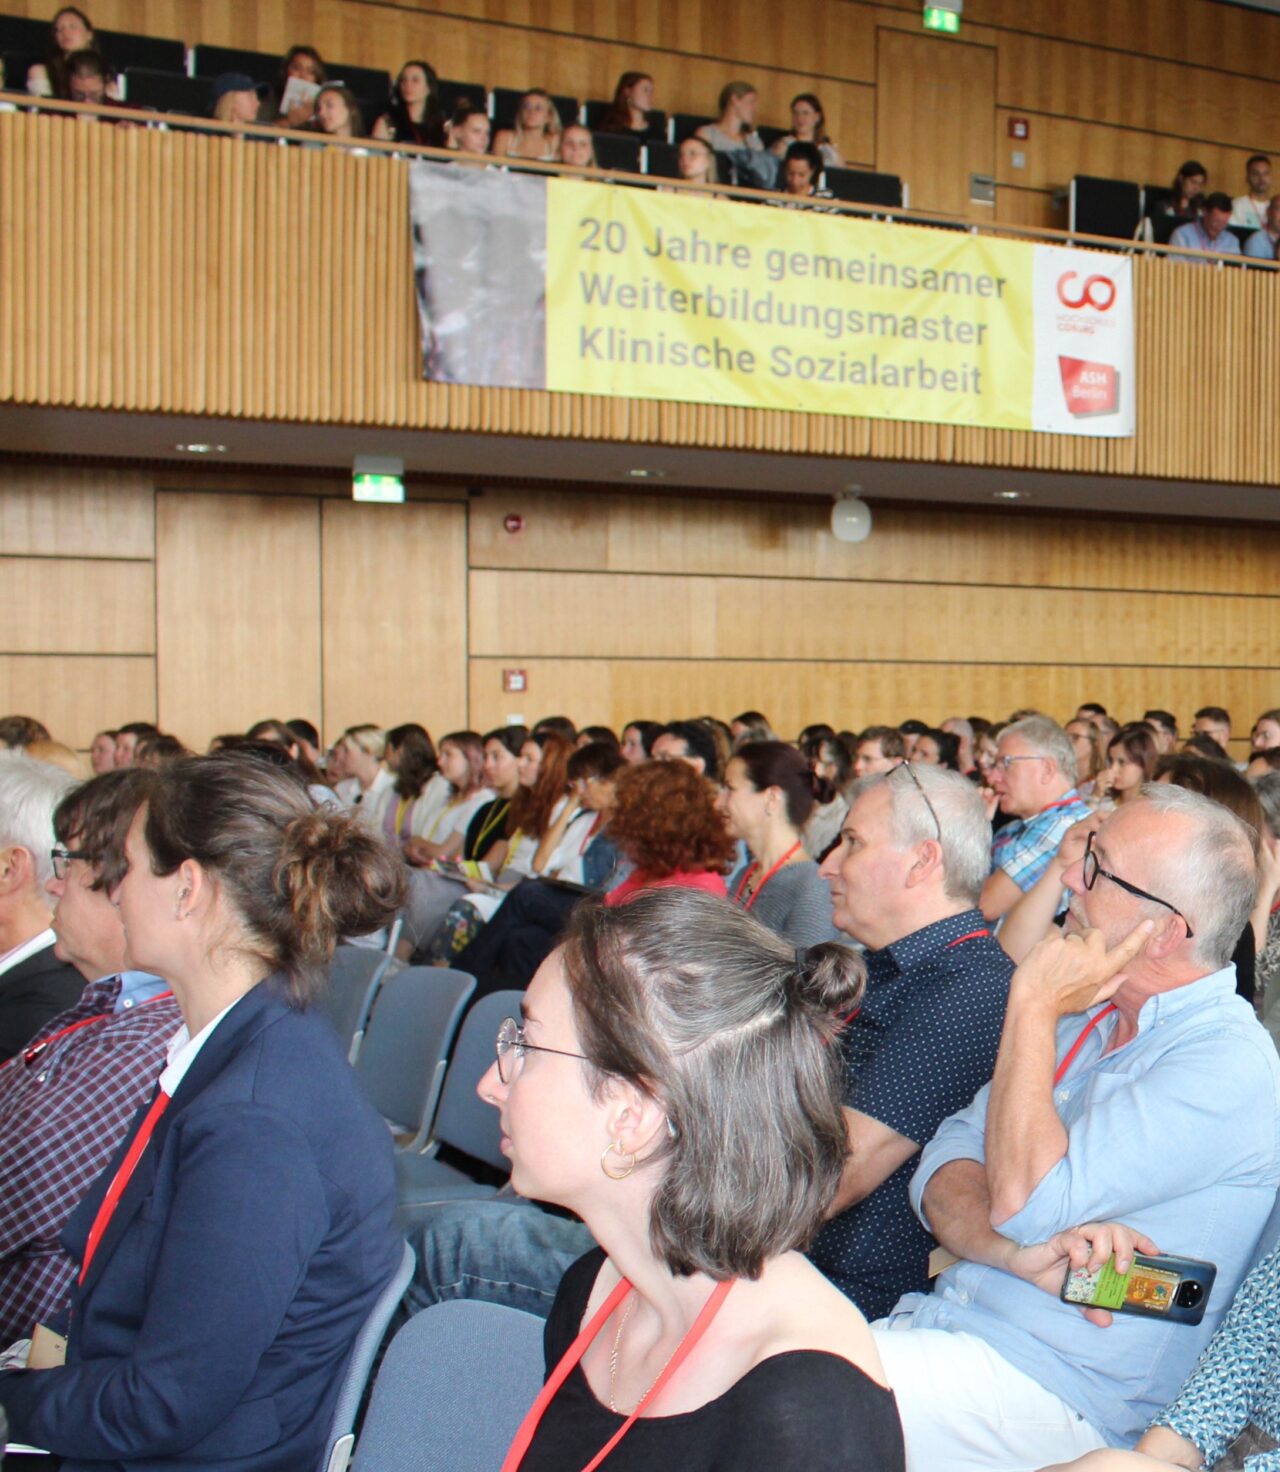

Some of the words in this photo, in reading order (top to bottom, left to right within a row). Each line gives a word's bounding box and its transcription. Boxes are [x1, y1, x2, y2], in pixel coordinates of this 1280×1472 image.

[579, 217, 627, 254] 20
[644, 227, 751, 269] Jahre
[766, 249, 1006, 299] gemeinsamer
[579, 271, 988, 346] Weiterbildungsmaster
[579, 325, 756, 374] Klinische
[770, 346, 982, 395] Sozialarbeit
[1071, 384, 1108, 401] Berlin
[1079, 369, 1109, 386] ASH
